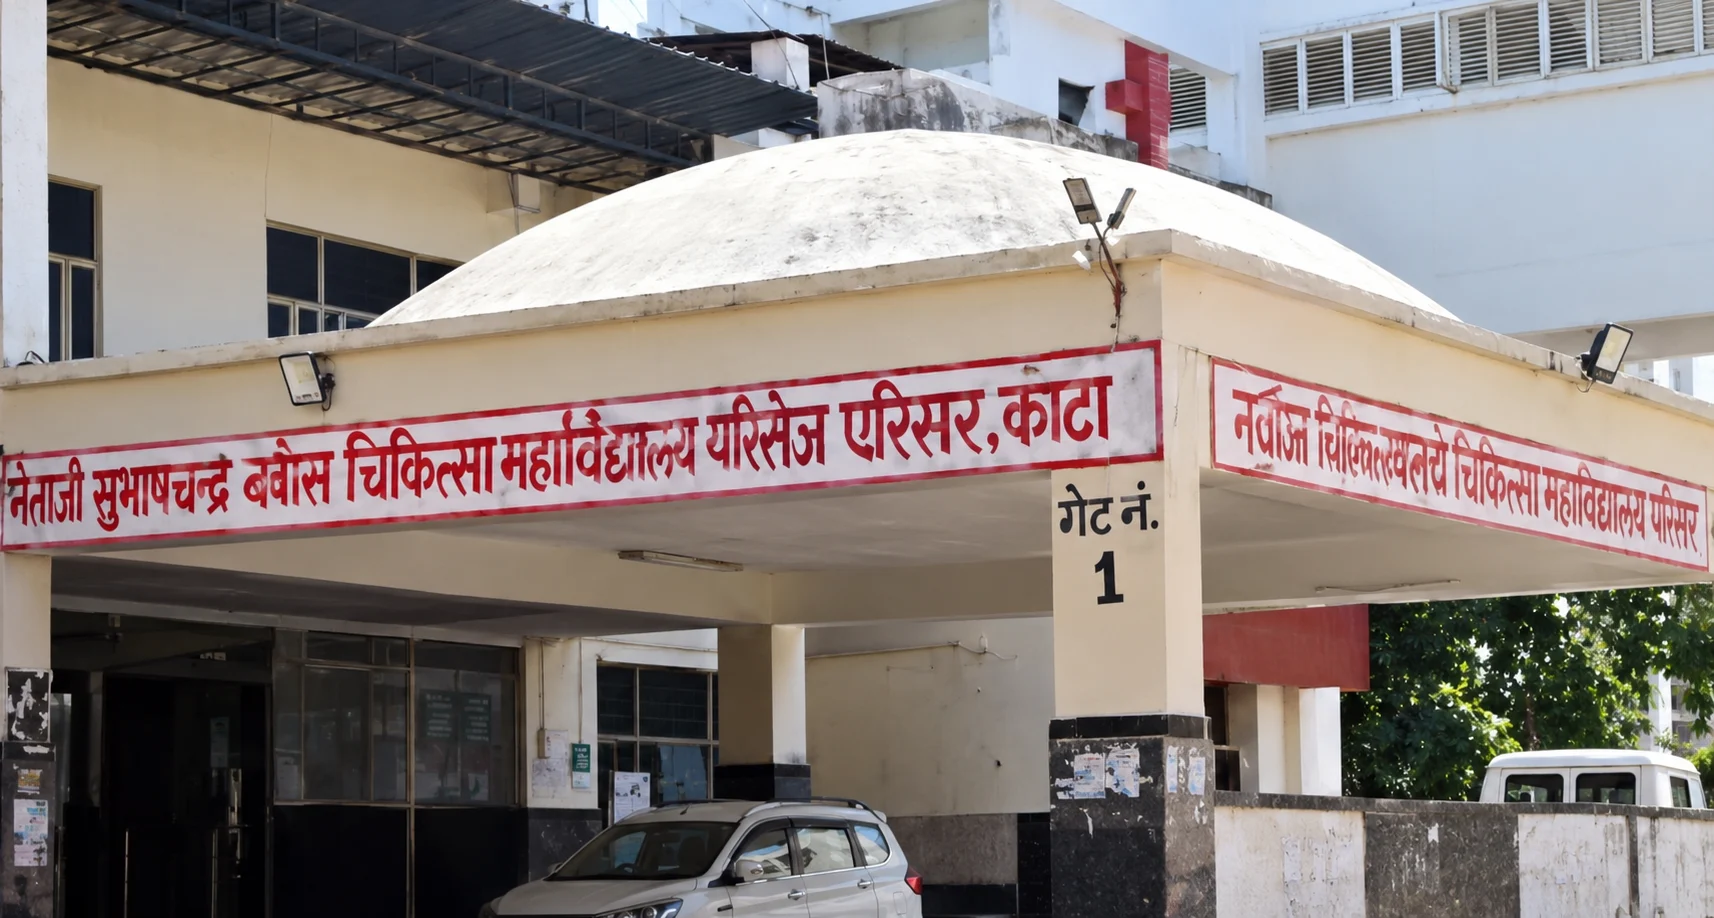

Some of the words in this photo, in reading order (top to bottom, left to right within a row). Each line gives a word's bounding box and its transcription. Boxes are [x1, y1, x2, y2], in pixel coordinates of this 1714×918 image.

[7, 456, 85, 527] नेताजी
[343, 427, 498, 502] चिकित्सा
[1057, 483, 1114, 537] गेट
[1120, 480, 1159, 531] नं.
[1451, 429, 1541, 518] चिकित्सा
[1542, 461, 1647, 541] महाविद्यालय
[1649, 483, 1700, 552] परिसर
[1094, 551, 1124, 605] 1
